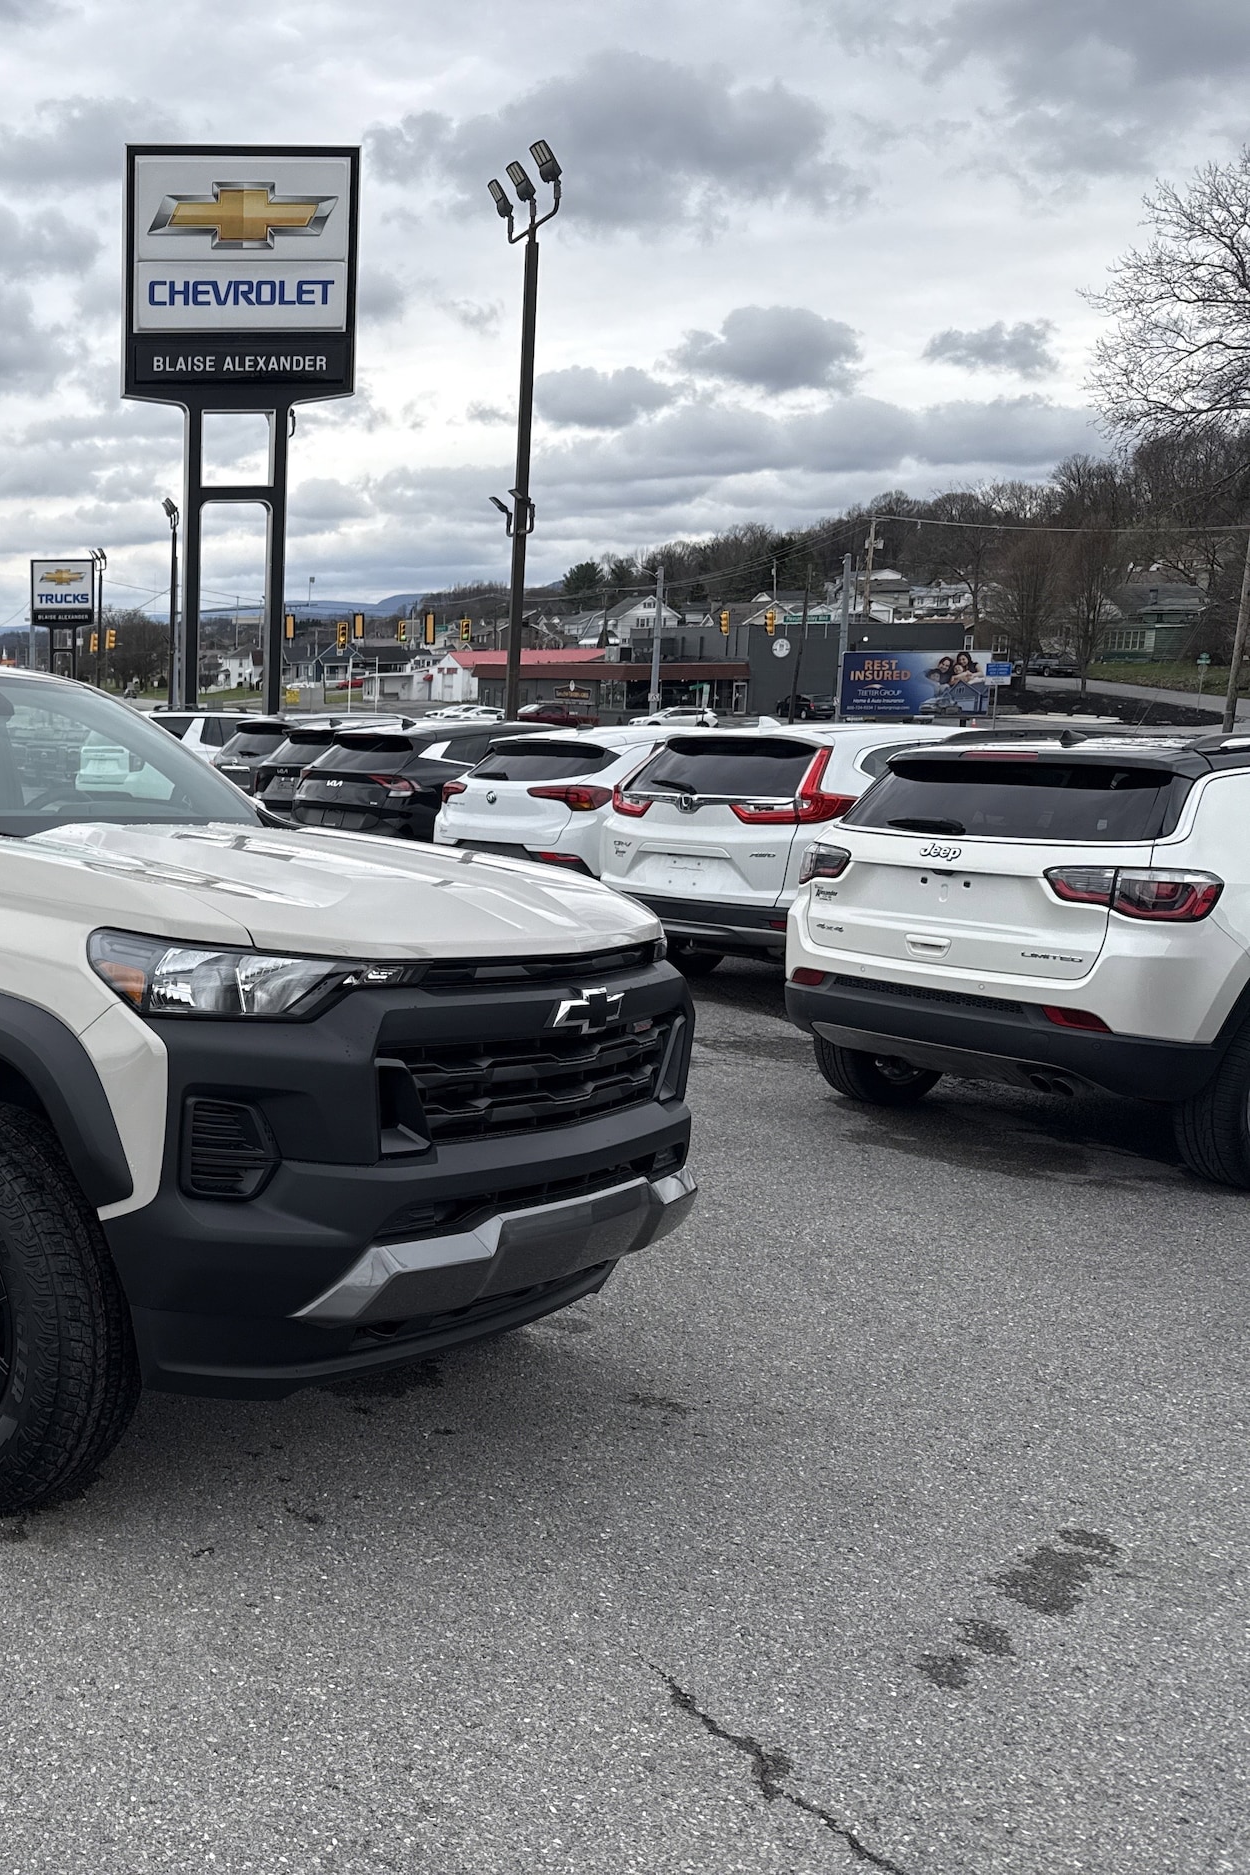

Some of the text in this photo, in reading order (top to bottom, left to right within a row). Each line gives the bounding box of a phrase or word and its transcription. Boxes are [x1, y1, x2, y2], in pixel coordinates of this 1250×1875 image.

[148, 279, 335, 306] CHEVROLET
[152, 355, 327, 372] BLAISE ALEXANDER
[37, 593, 90, 604] TRUCKS
[864, 659, 899, 671] REST
[850, 670, 912, 681] INSURED
[857, 689, 902, 697] TEETER GROUP
[919, 843, 962, 861] Jeep
[816, 922, 845, 933] 4x4
[1020, 950, 1084, 964] LIMITED
